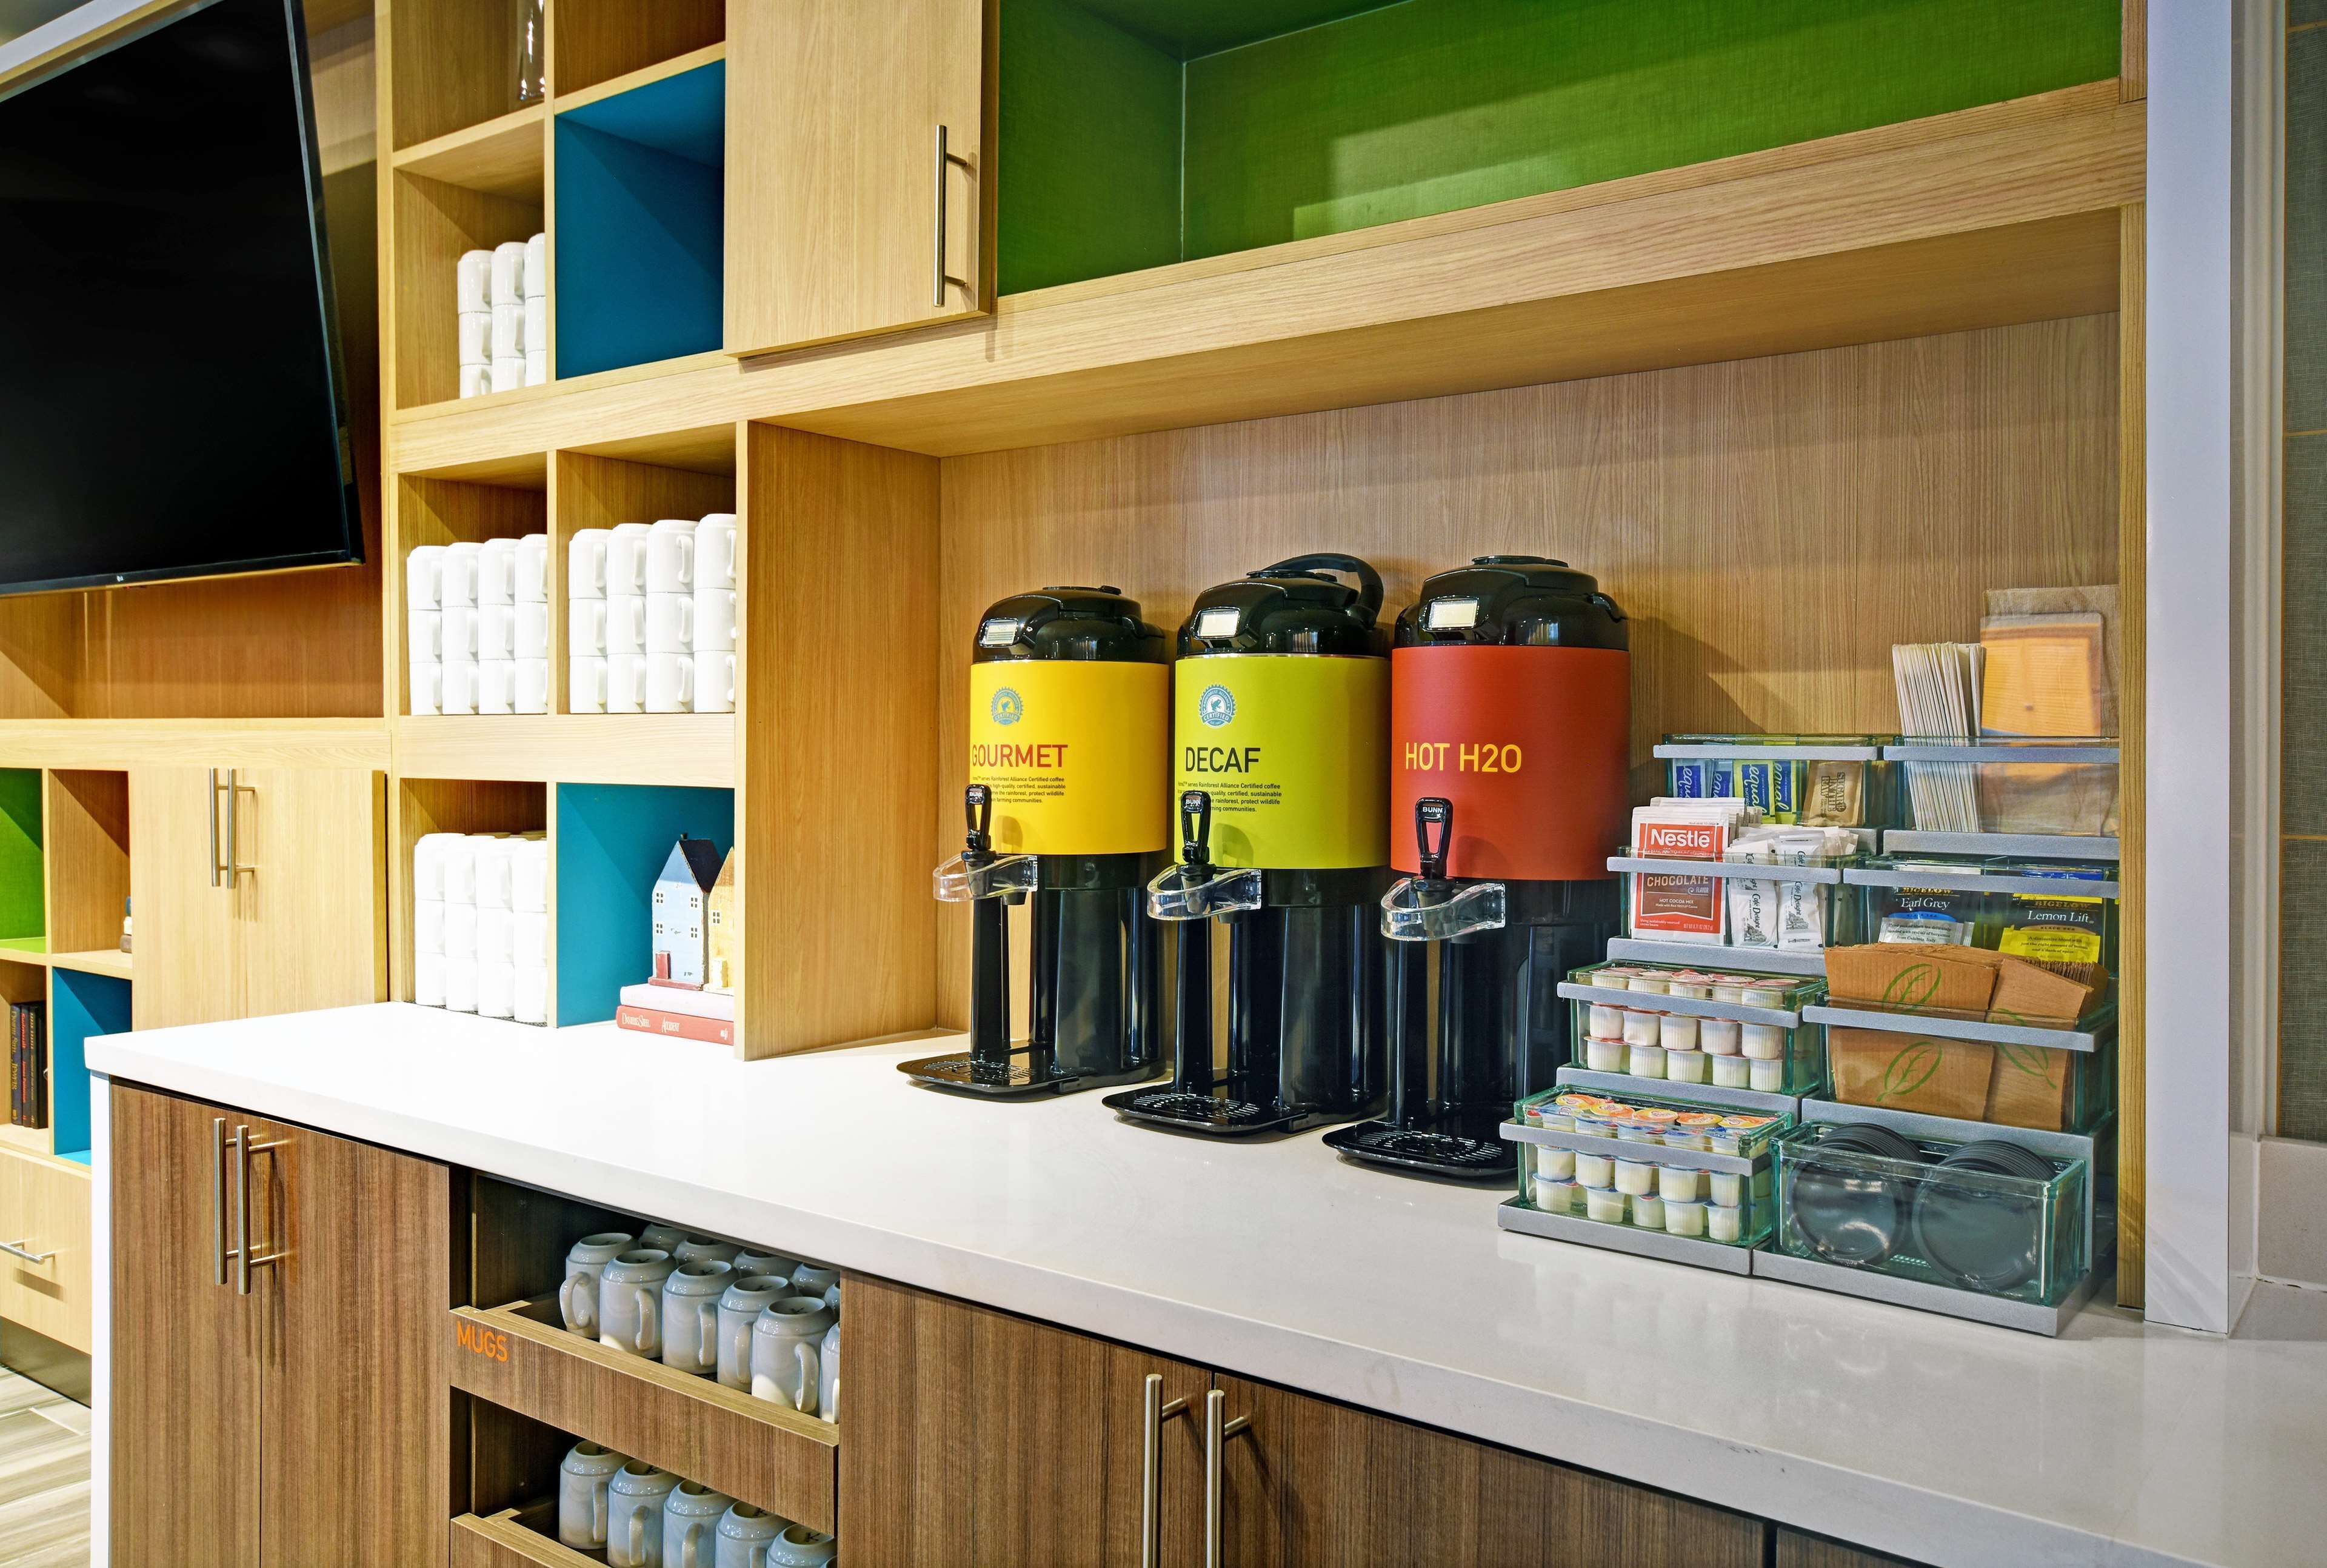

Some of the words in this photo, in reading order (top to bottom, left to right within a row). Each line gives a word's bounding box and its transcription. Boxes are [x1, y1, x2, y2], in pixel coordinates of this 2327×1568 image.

[1203, 712, 1229, 721] CERTIFIED
[972, 744, 1068, 767] GOURMET
[1186, 747, 1261, 773] DECAF
[1406, 742, 1451, 771] HOT
[1821, 776, 1829, 796] RAW
[1837, 772, 1845, 804] SUGAR
[1752, 893, 1761, 907] Café
[1793, 895, 1801, 915] Delight
[1901, 898, 1921, 908] Earl
[1923, 898, 1951, 910] Grey
[1752, 907, 1761, 929] Delight
[2028, 910, 2066, 921] Lemon
[2069, 912, 2089, 922] Lift
[456, 1321, 509, 1363] MUGS
